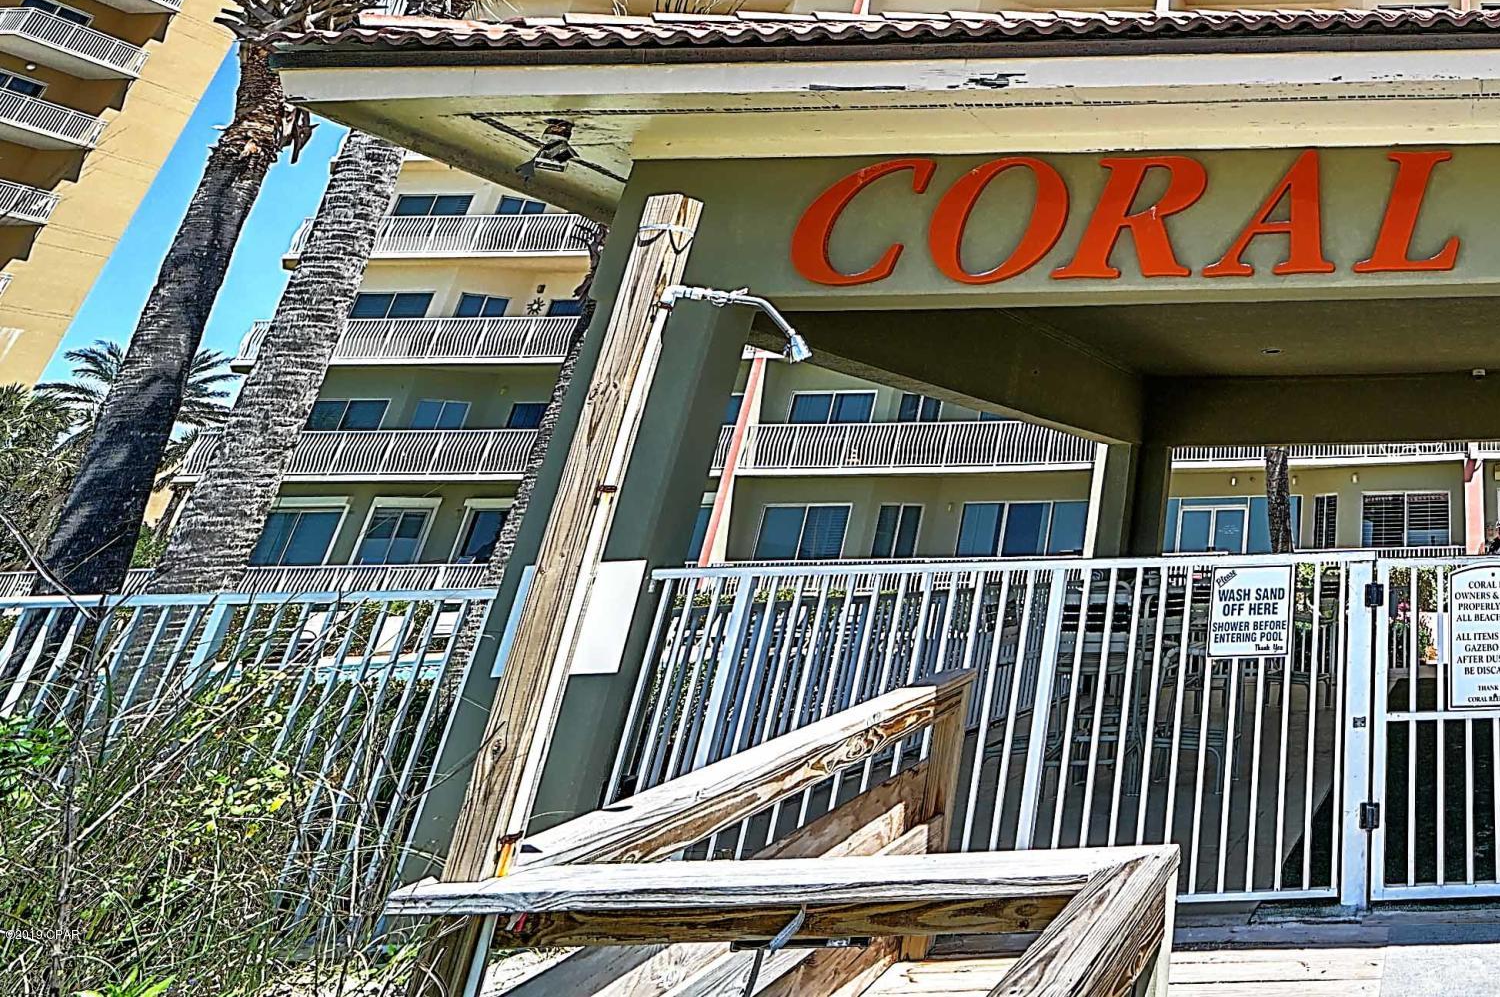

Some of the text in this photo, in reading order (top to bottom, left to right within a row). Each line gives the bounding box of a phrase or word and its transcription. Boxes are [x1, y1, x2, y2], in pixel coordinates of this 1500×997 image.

[791, 150, 1461, 287] CORAL
[1468, 581, 1497, 589] CORAL
[1218, 587, 1285, 602] WASH SAND
[1454, 592, 1491, 600] OWNERS
[1492, 592, 1500, 600] &
[1222, 602, 1278, 617] OFF HERE
[1458, 602, 1500, 611] PROPERLY
[1456, 614, 1472, 622] ALL
[1212, 620, 1287, 632] SHOWER BEFORE
[1214, 631, 1283, 644] ENTERING POOL
[1456, 633, 1472, 641] ALL
[1473, 632, 1499, 641] ITEMS
[1464, 643, 1499, 652] GAZEBO
[1456, 655, 1484, 664] AFTER
[1464, 667, 1475, 675] BE
